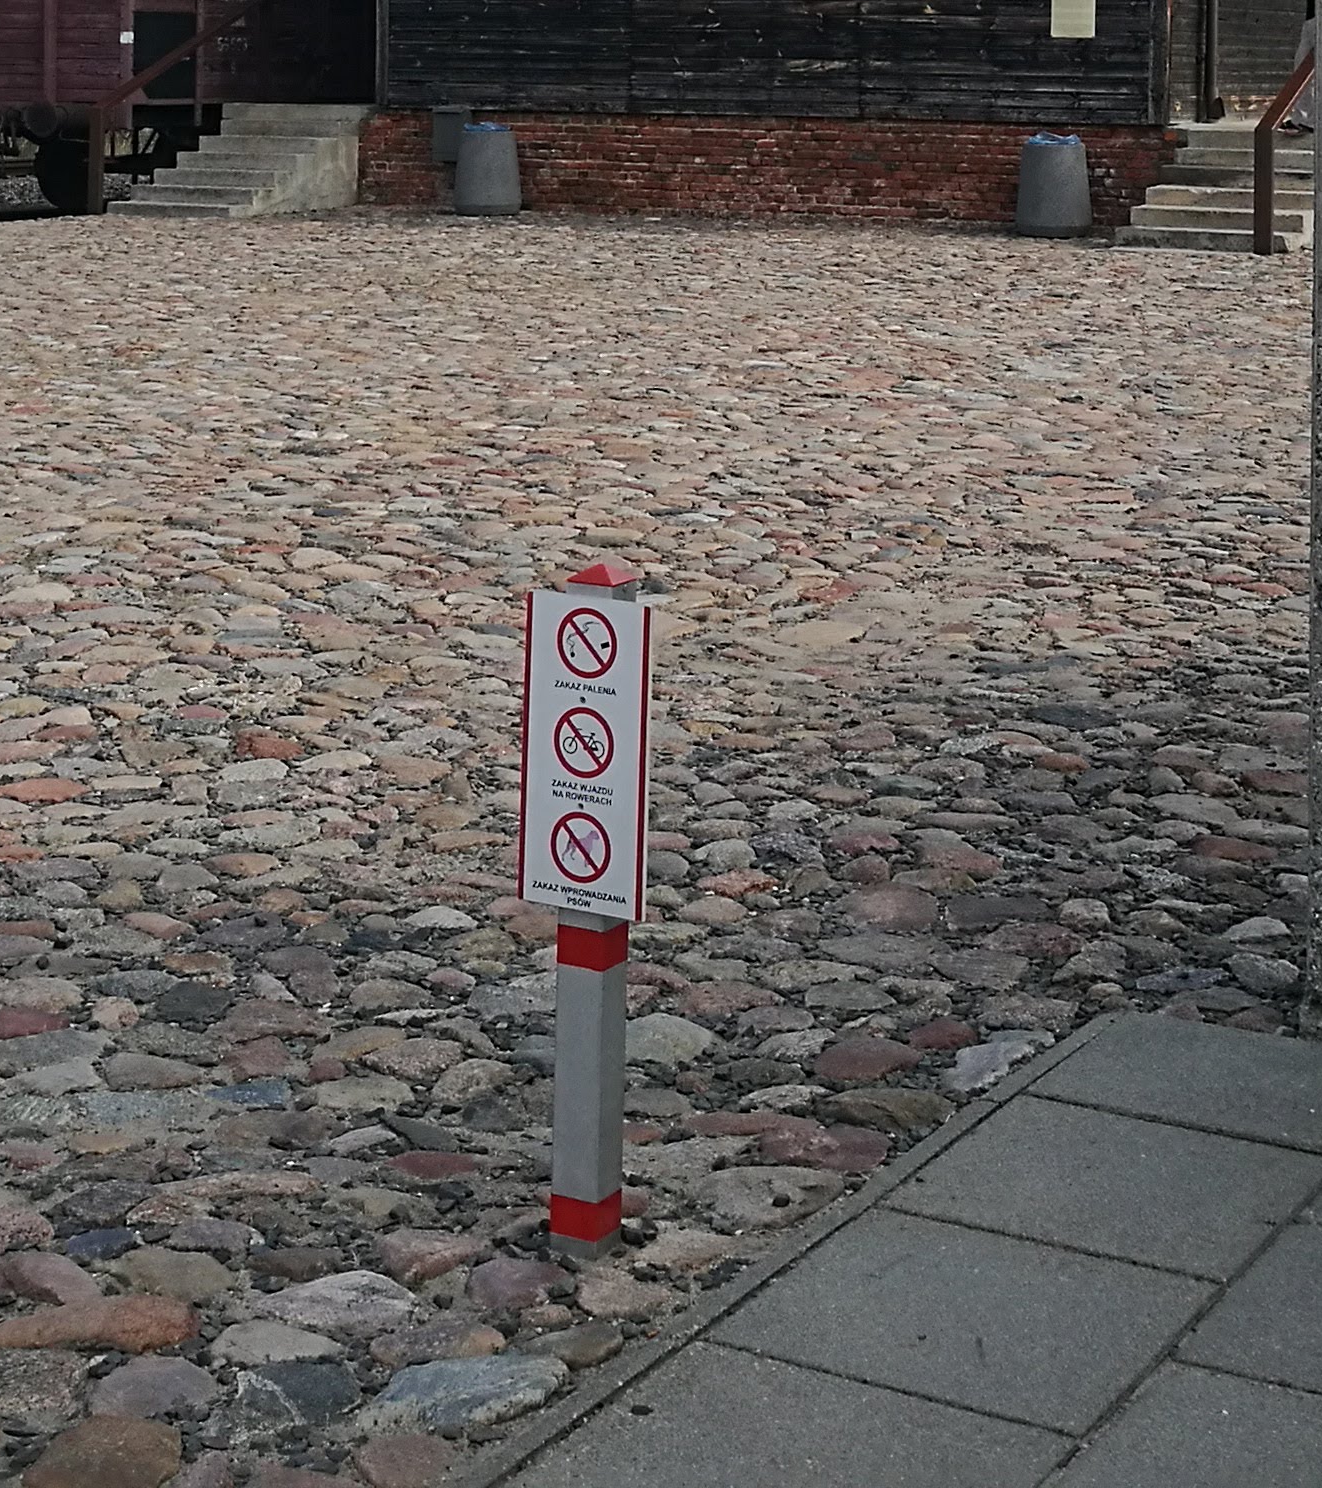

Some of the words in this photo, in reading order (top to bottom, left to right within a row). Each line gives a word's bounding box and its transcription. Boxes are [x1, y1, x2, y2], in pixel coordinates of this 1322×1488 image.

[554, 679, 582, 691] ZAKAZ
[582, 683, 617, 696] PALENIA
[551, 778, 578, 791] ZAKAZ
[579, 783, 614, 797] WJAZDU
[552, 789, 564, 799] NA
[565, 791, 613, 807] ROWERACH
[532, 880, 559, 893] ZAKAZ
[560, 885, 627, 905] WPROWADZANIA
[566, 896, 592, 908] PSÓW
